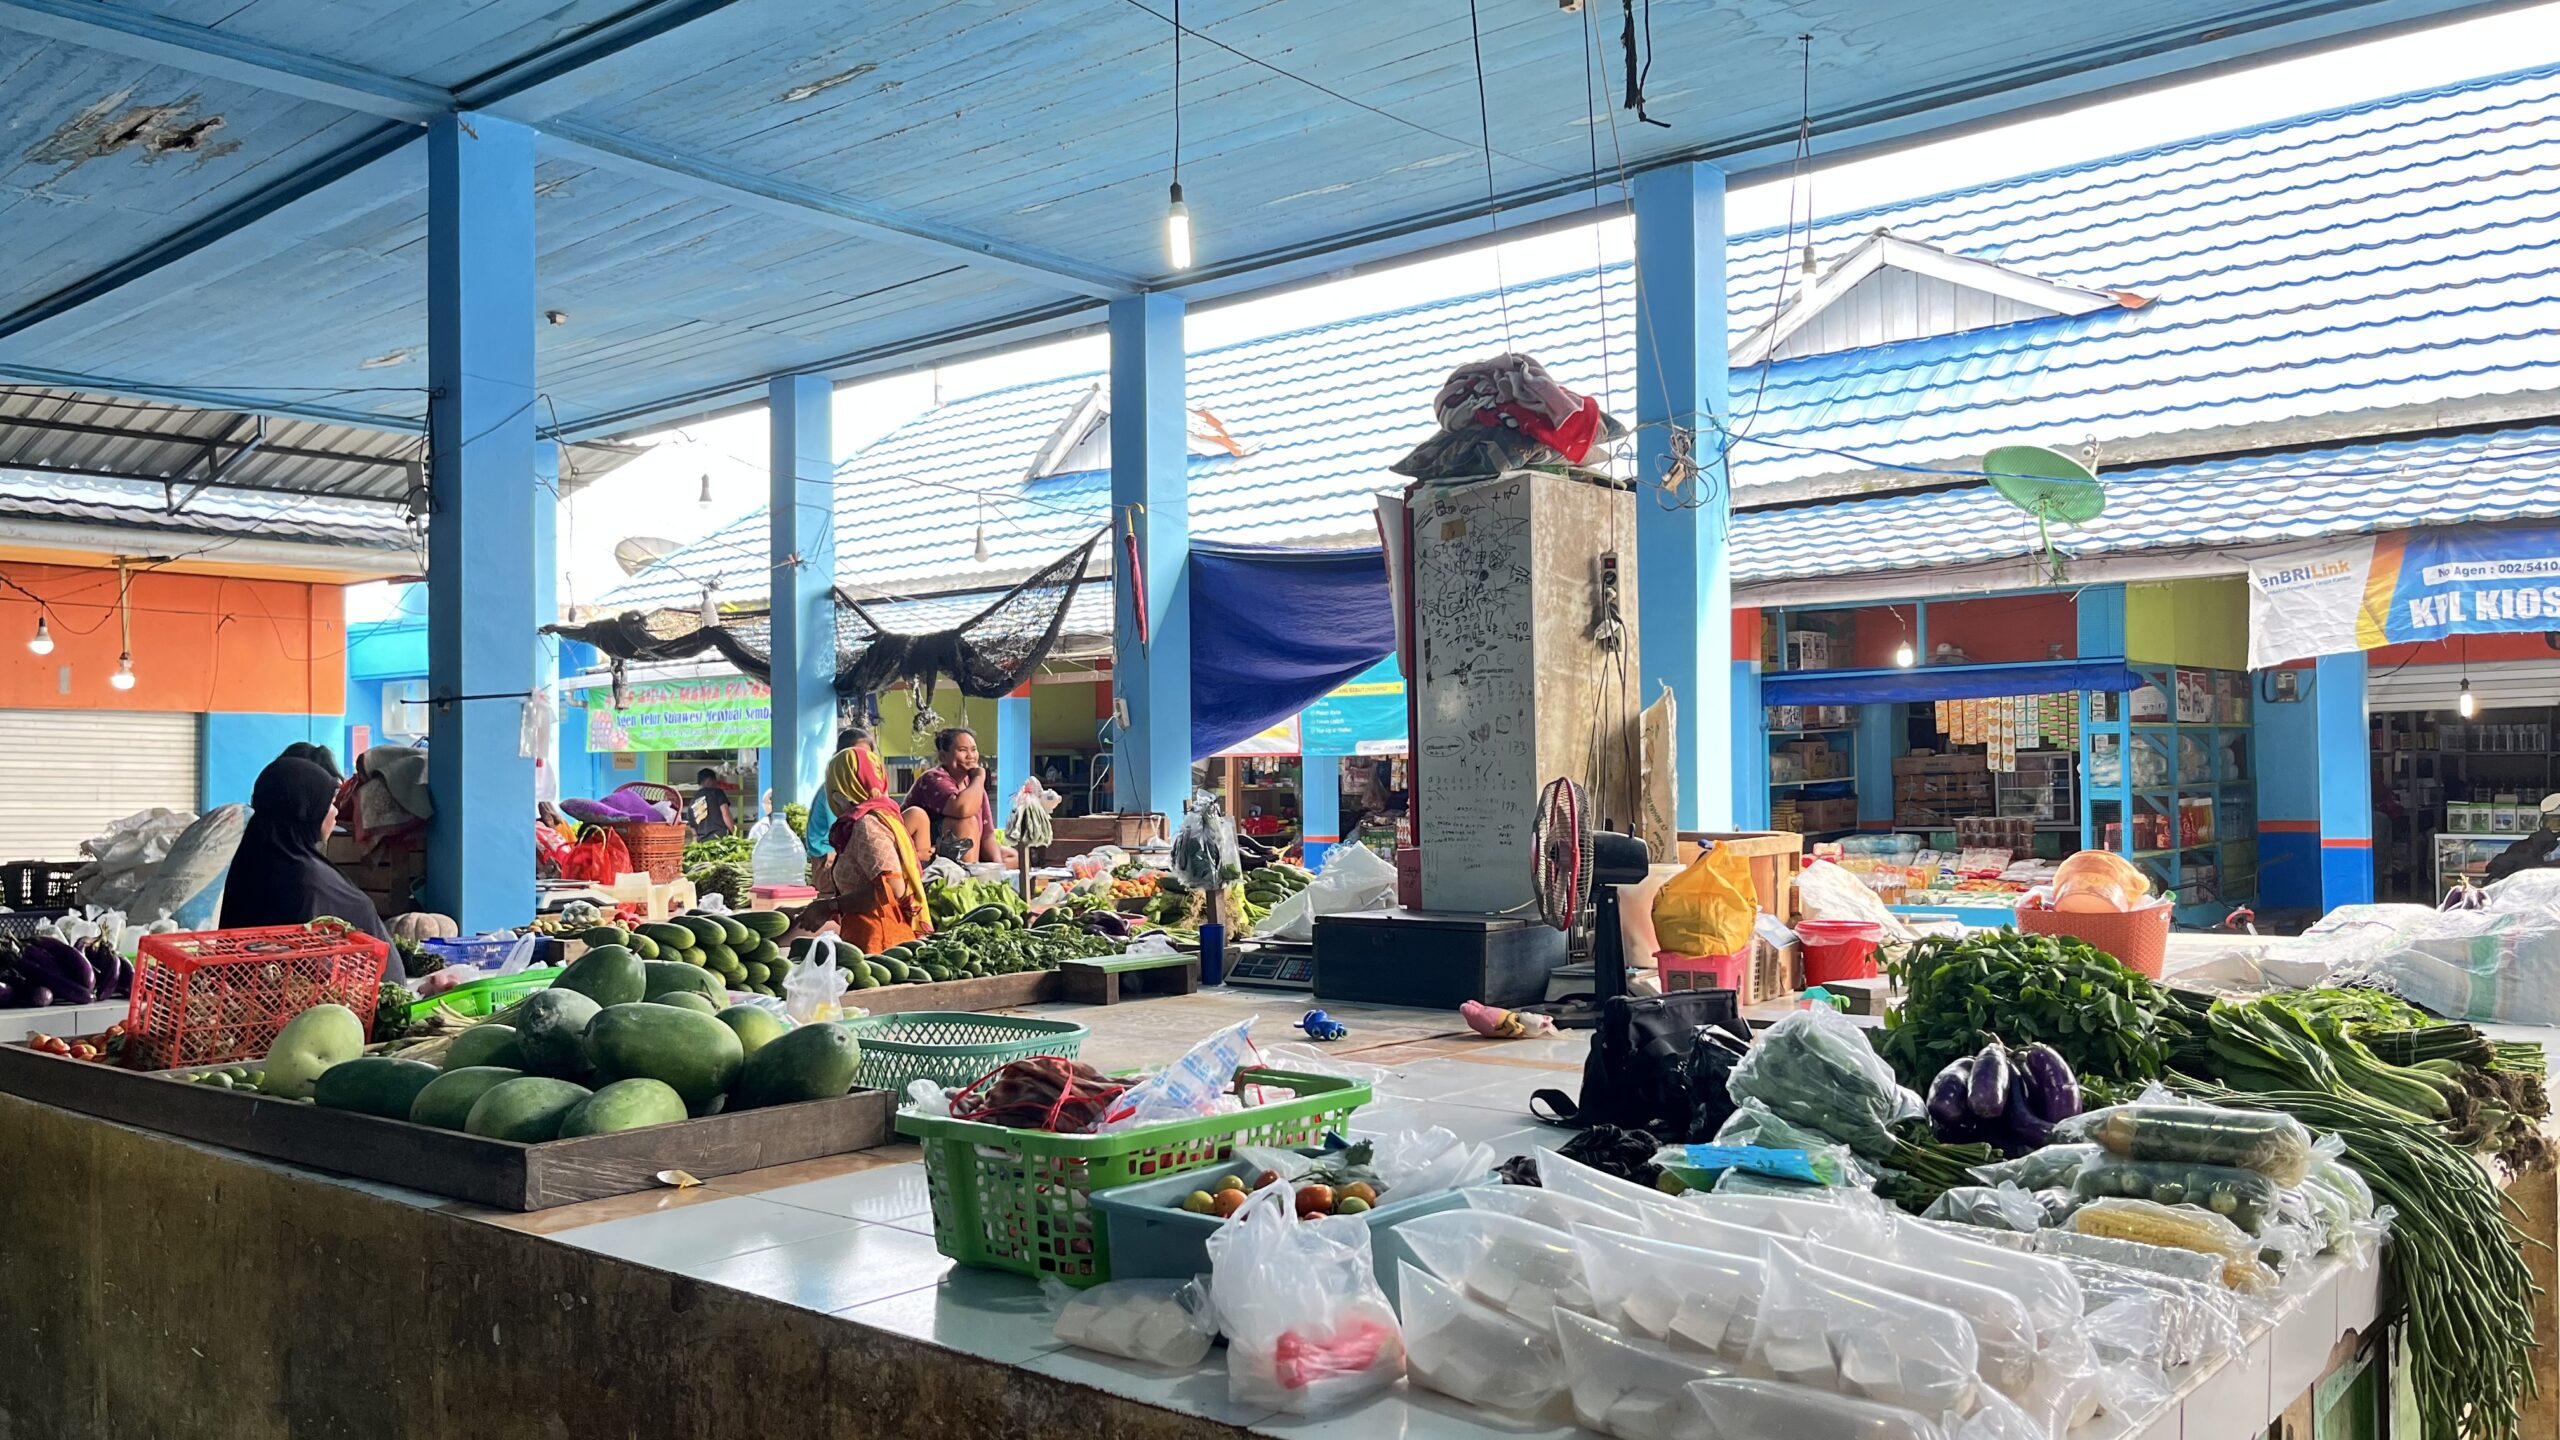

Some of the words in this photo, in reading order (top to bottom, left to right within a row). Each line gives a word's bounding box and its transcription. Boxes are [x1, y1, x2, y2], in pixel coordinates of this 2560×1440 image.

[2260, 560, 2350, 588] enBRILink
[2455, 566, 2486, 577] Agen
[2498, 561, 2560, 573] 002/5410
